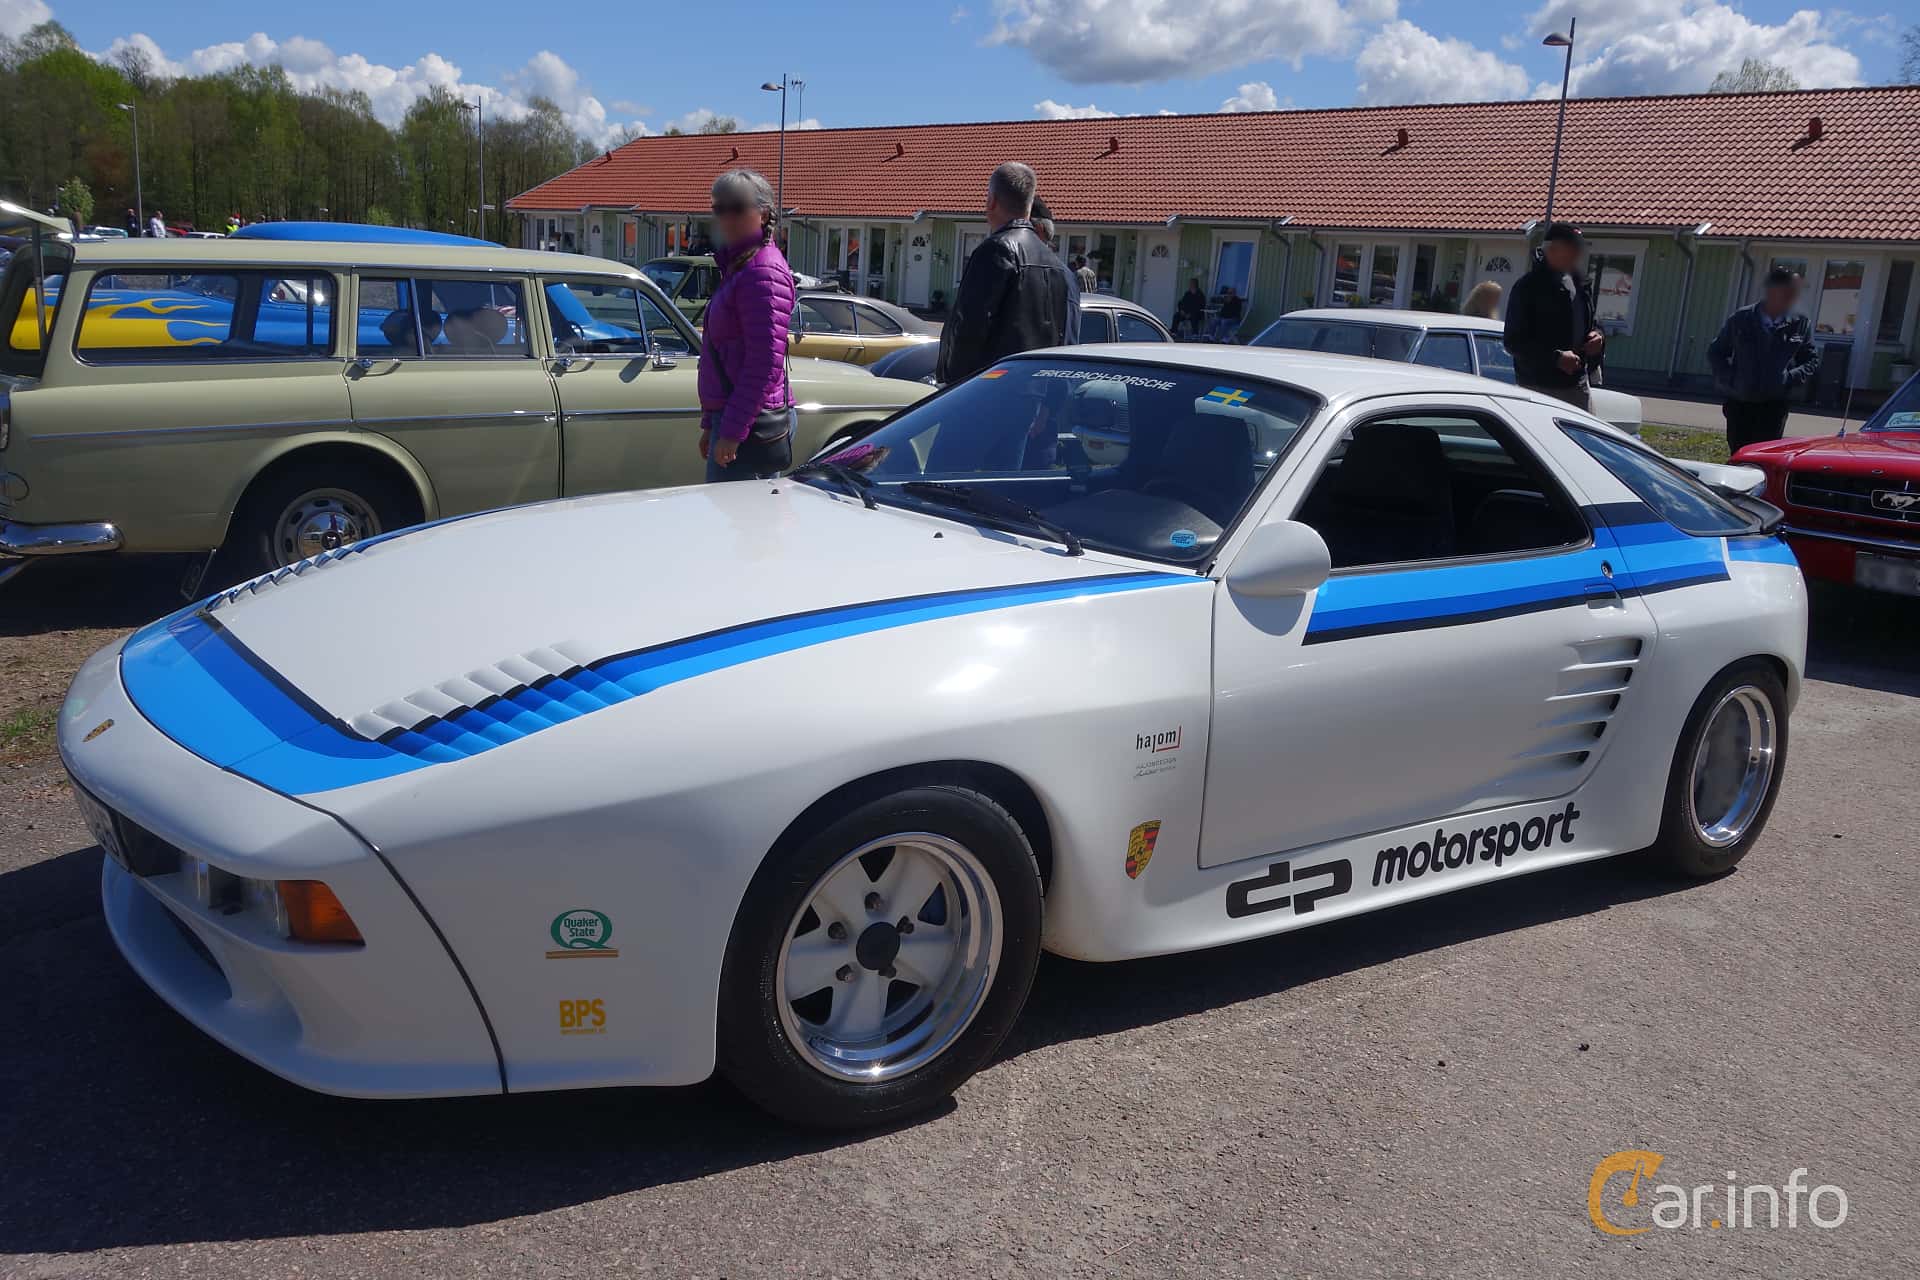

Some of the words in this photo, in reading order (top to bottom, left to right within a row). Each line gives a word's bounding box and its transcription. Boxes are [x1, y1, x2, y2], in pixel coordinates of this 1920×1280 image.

[1371, 802, 1581, 888] motorsport
[563, 918, 600, 929] Quaker
[569, 927, 596, 937] State
[559, 998, 607, 1027] BPS
